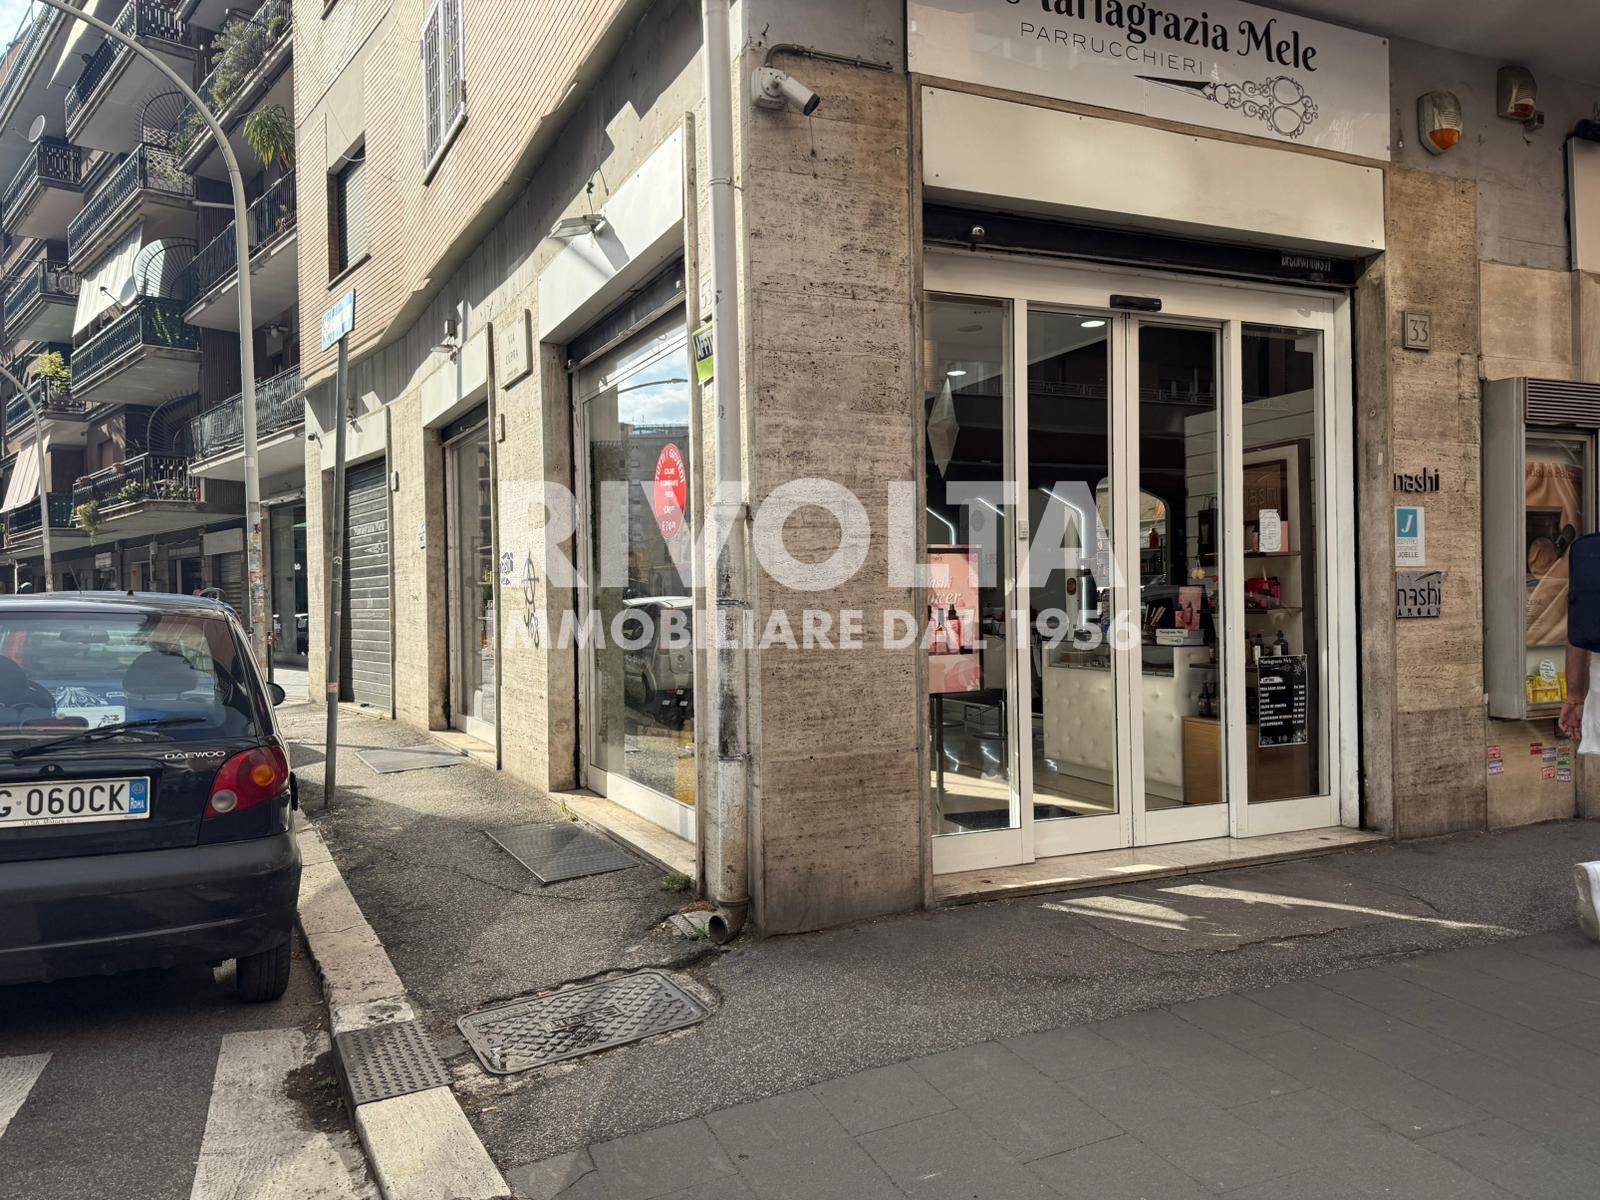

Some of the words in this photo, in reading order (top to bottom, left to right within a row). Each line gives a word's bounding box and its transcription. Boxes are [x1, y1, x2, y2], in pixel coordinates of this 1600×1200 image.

[1005, 0, 1229, 52] ariagrazia
[1237, 18, 1318, 72] Mele
[1020, 22, 1203, 75] PARRUCCHIERI
[1409, 319, 1428, 342] 33
[1393, 466, 1440, 493] nashi
[1401, 514, 1414, 533] J
[1397, 581, 1441, 606] nashi
[164, 750, 226, 760] DAEWOO
[27, 783, 126, 816] 060CK
